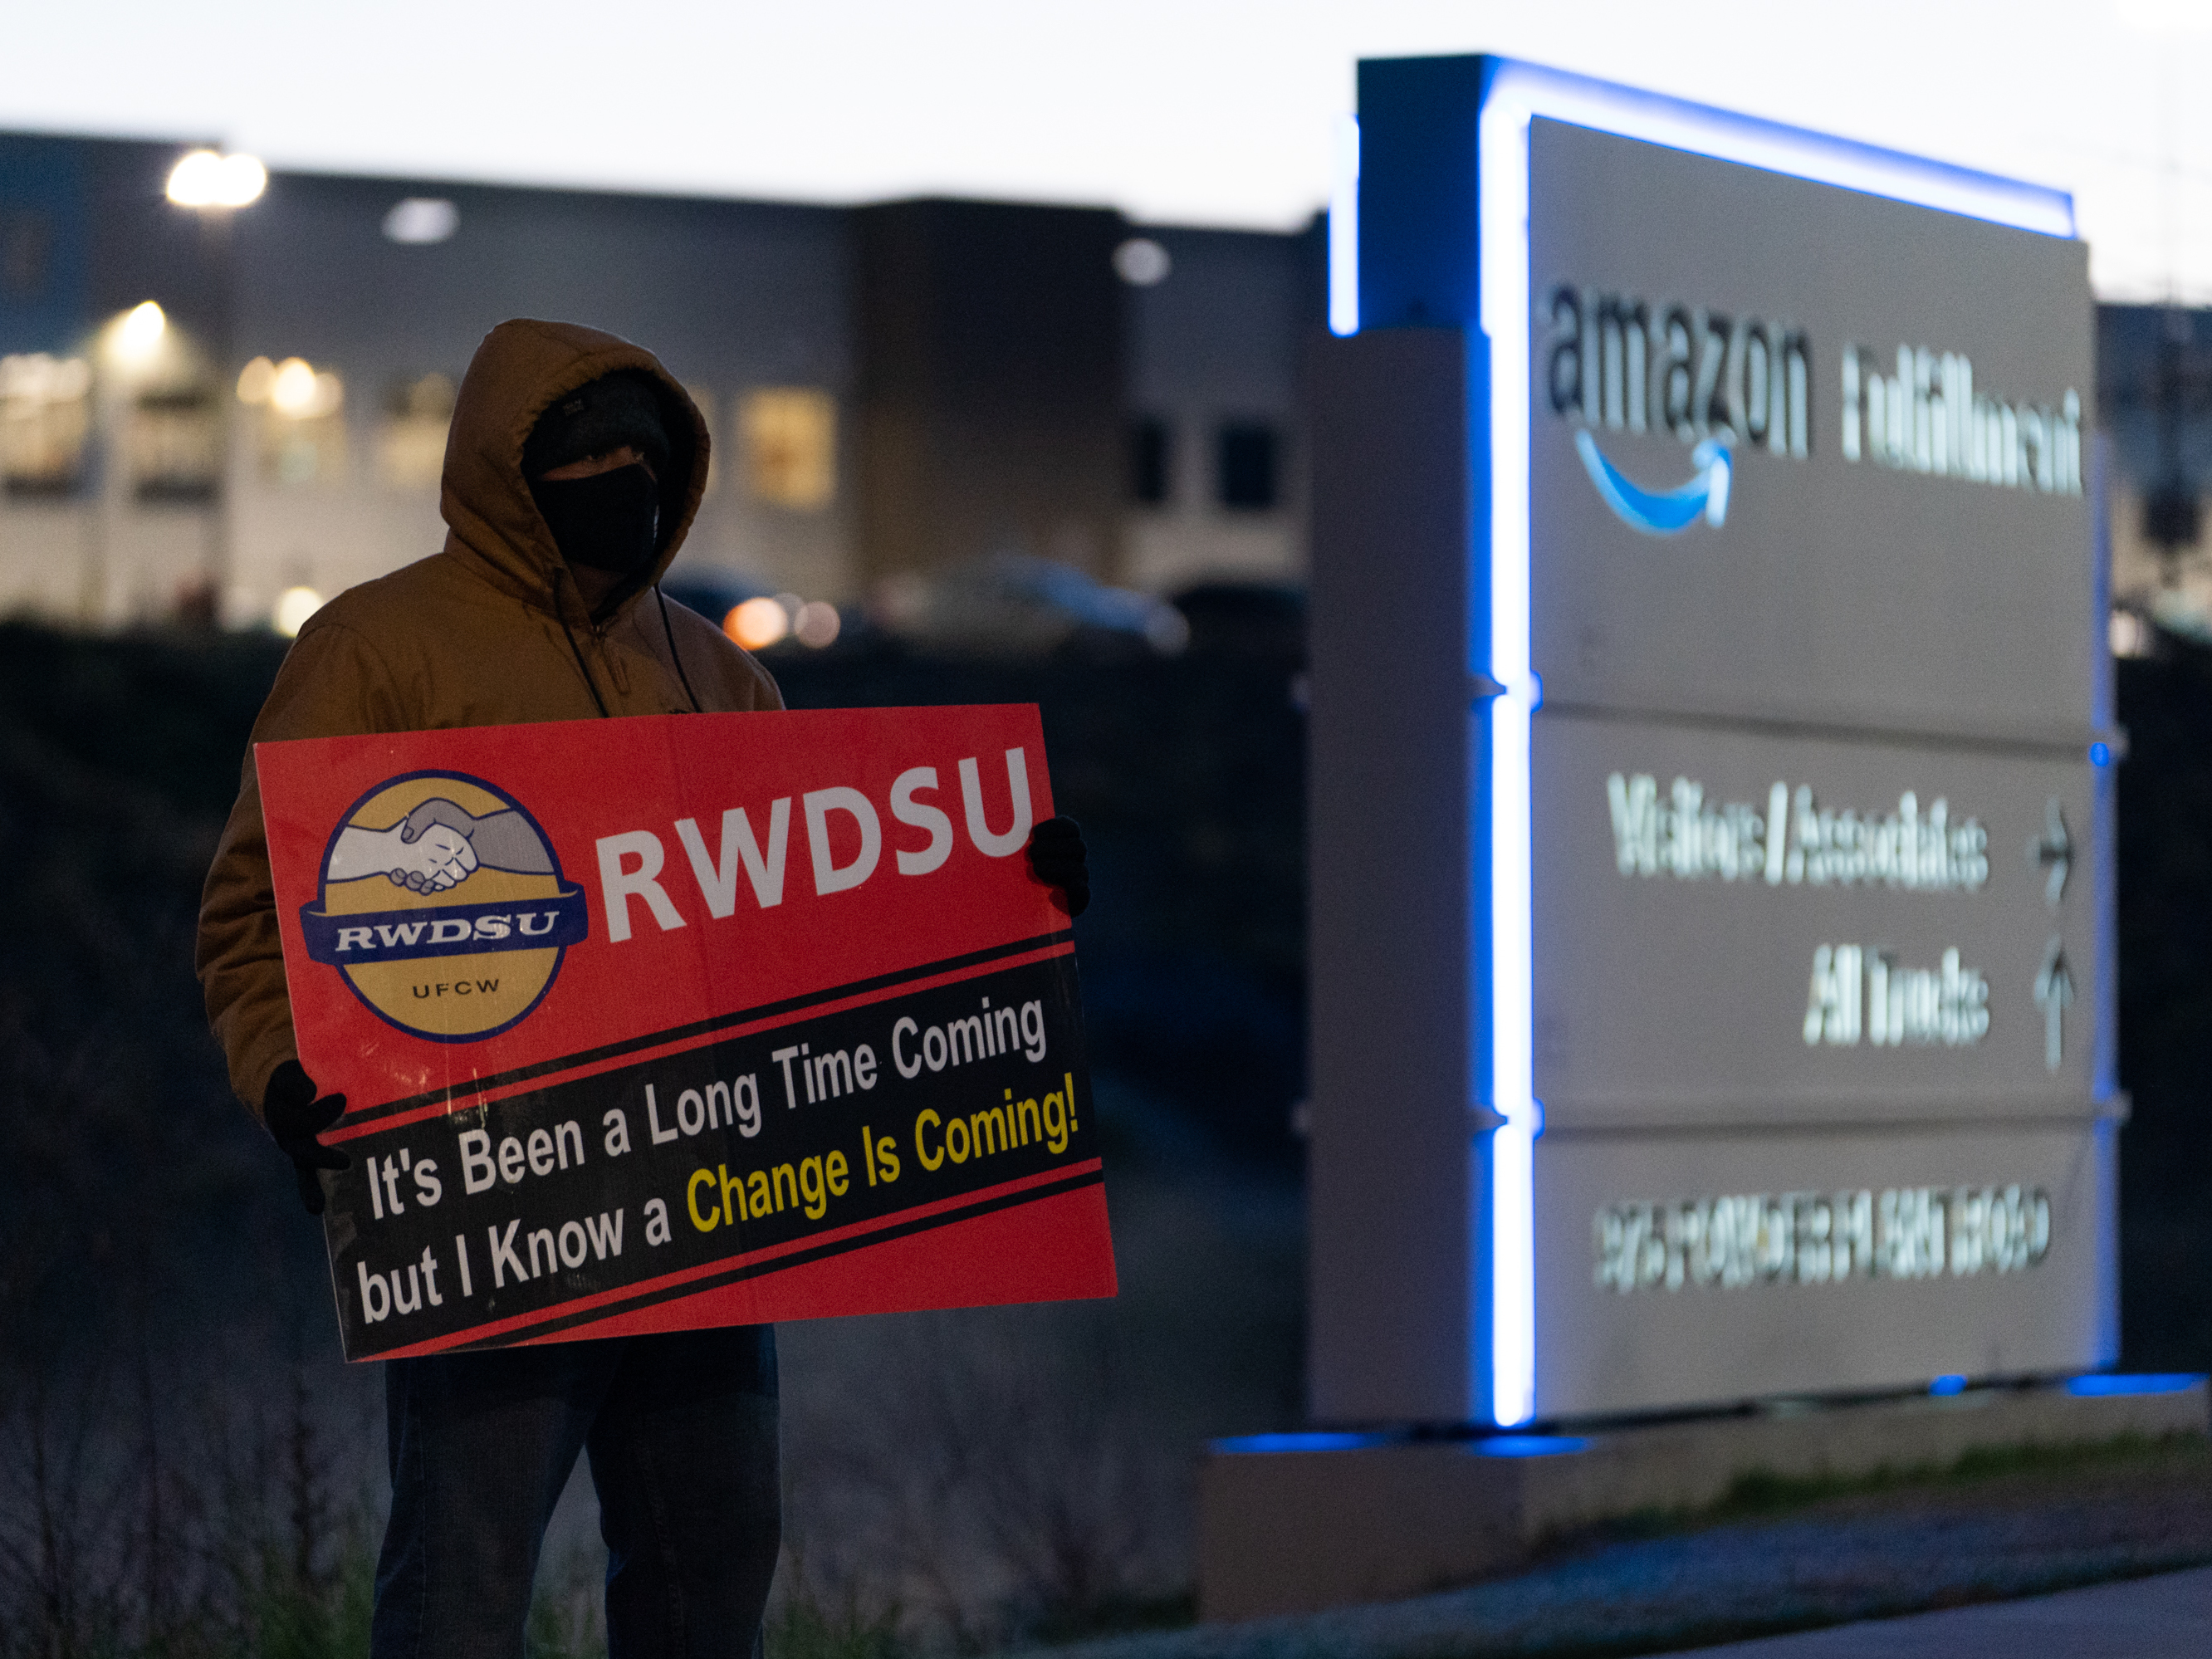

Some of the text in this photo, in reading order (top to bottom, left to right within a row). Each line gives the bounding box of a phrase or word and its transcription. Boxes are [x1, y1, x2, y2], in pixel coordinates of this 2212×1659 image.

[1548, 282, 1814, 462] amazon
[335, 910, 560, 952] RWDSU
[595, 746, 1033, 944] RWDSU
[412, 979, 500, 999] UFCW
[357, 1071, 1079, 1324] but I Know a Change Is Coming!
[366, 996, 1047, 1220] It's Been a Long Time Coming
